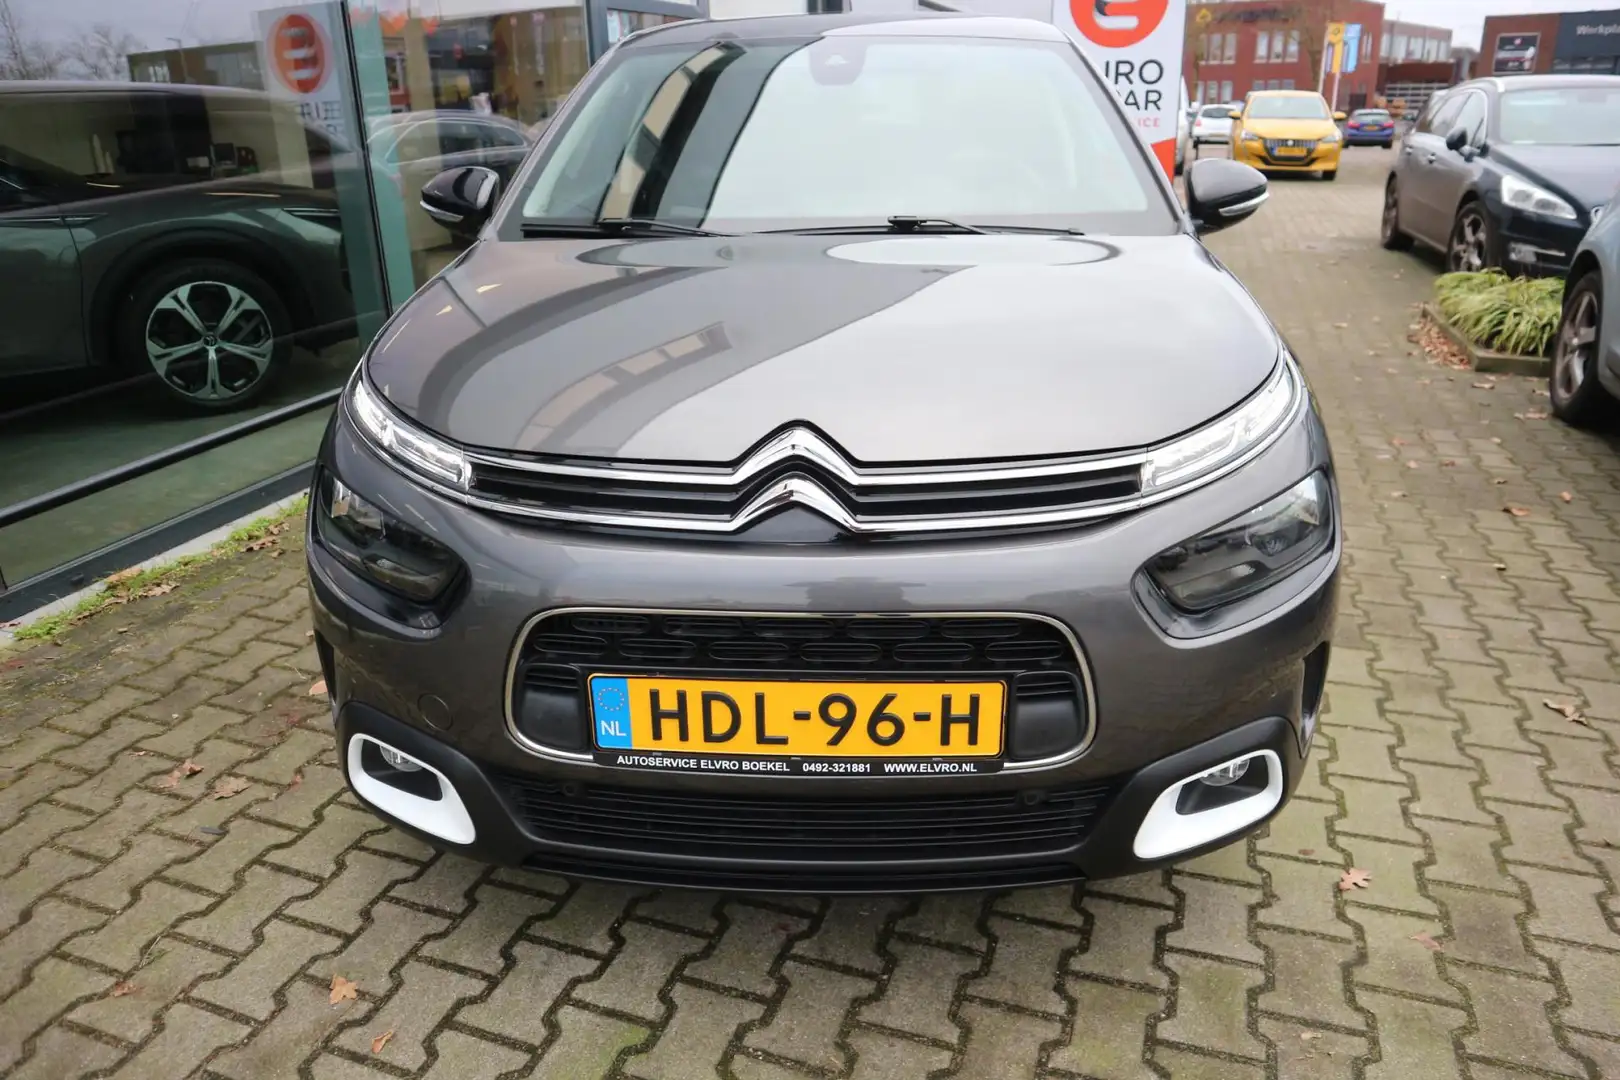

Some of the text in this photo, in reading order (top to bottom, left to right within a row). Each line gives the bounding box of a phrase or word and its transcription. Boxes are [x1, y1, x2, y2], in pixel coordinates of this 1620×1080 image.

[649, 688, 981, 747] HDL-96-H
[600, 719, 627, 738] NL
[616, 754, 978, 774] AUTOSERVICE ELVRO BOEKEL 0492-321881 WWW.ELVRO.NL
